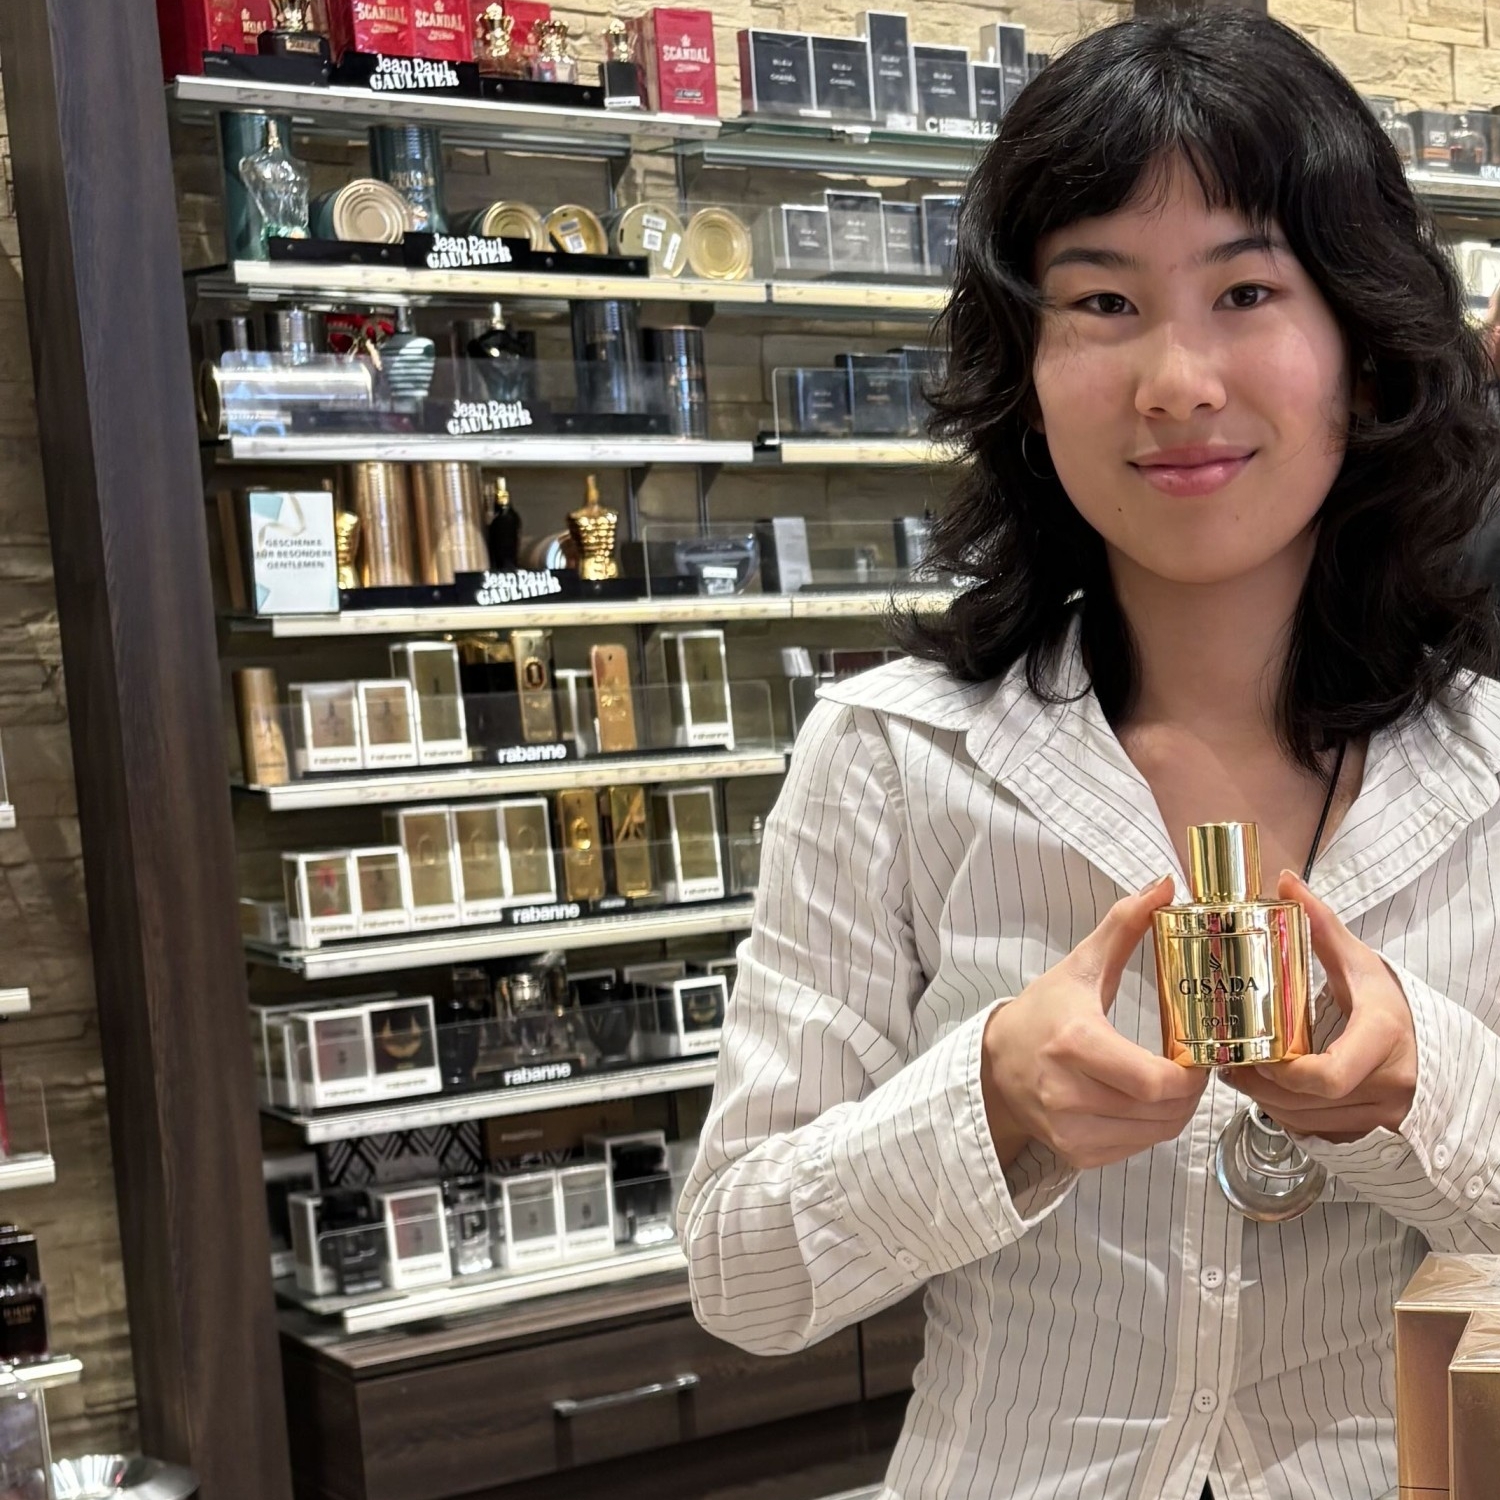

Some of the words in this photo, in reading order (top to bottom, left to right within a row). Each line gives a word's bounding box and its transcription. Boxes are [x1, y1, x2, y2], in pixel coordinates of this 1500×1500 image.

[663, 45, 711, 64] SCANDAL
[267, 561, 325, 570] GENTLEMEN
[498, 744, 567, 763] rabanne
[512, 903, 580, 924] rabanne
[1179, 976, 1260, 996] GISADA
[1201, 1014, 1240, 1028] GOLD
[504, 1062, 571, 1086] rabanne
